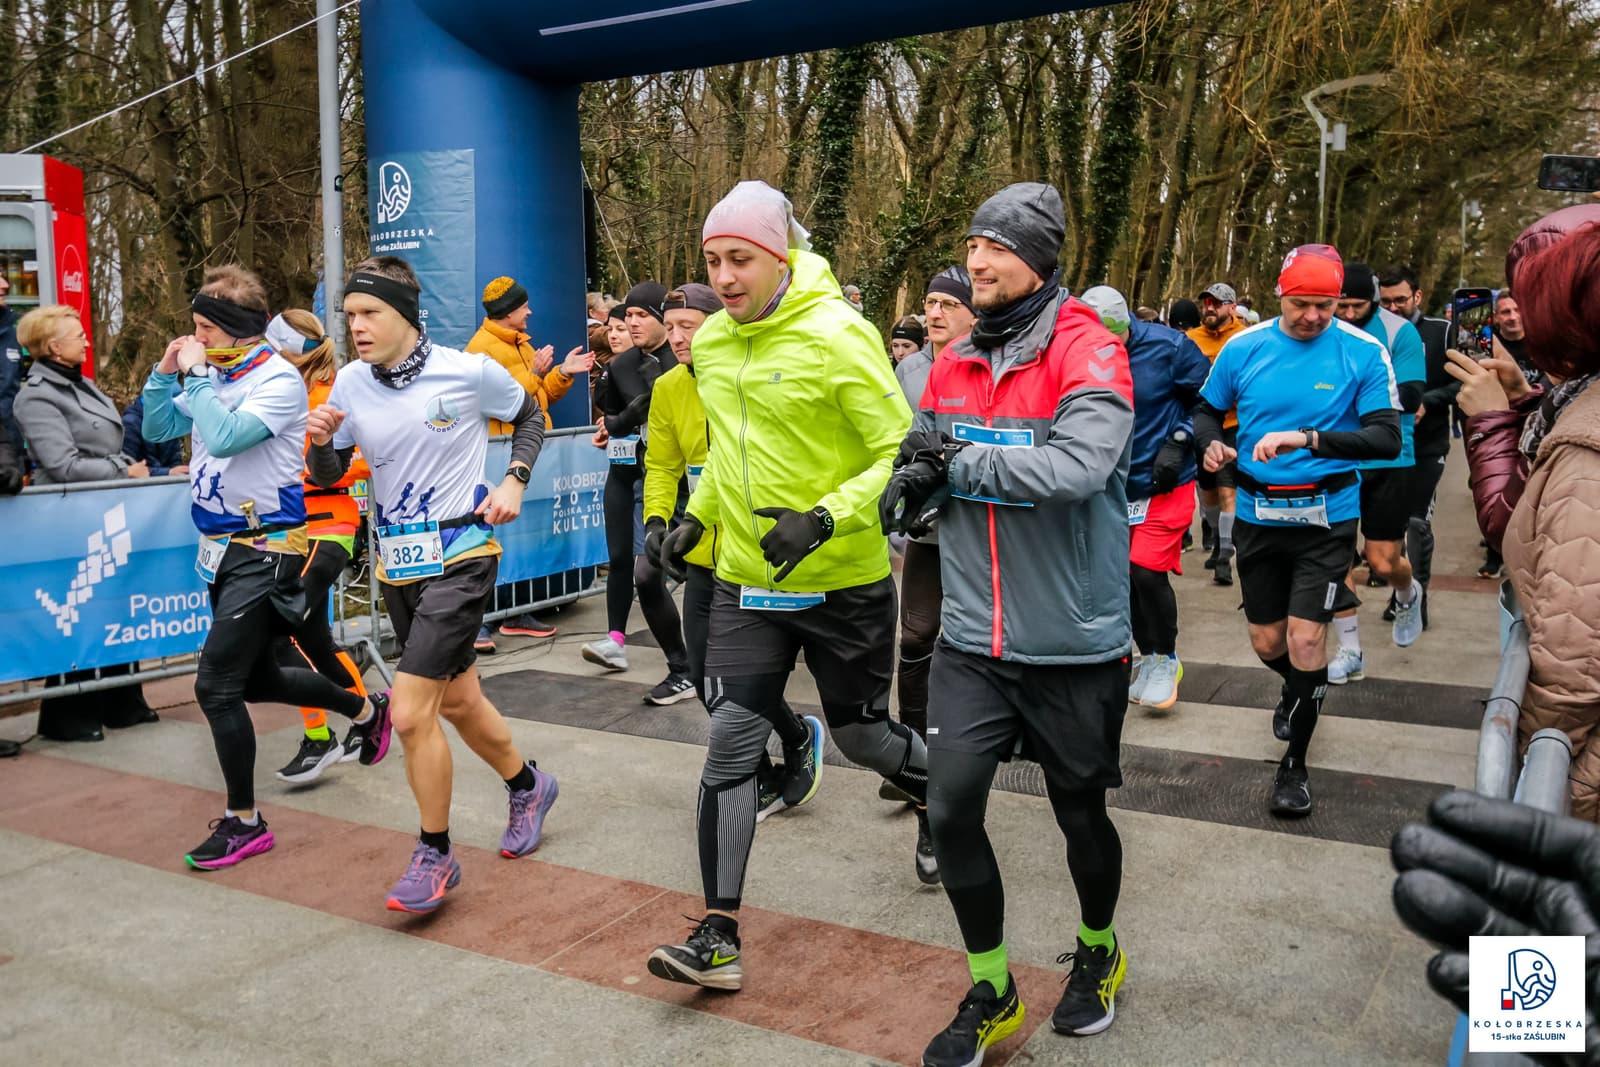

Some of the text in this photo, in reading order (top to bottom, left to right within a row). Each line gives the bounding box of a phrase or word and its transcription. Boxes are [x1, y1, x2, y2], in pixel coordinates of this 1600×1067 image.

[613, 446, 627, 457] 511
[553, 512, 606, 535] KULTU
[393, 545, 424, 565] 382
